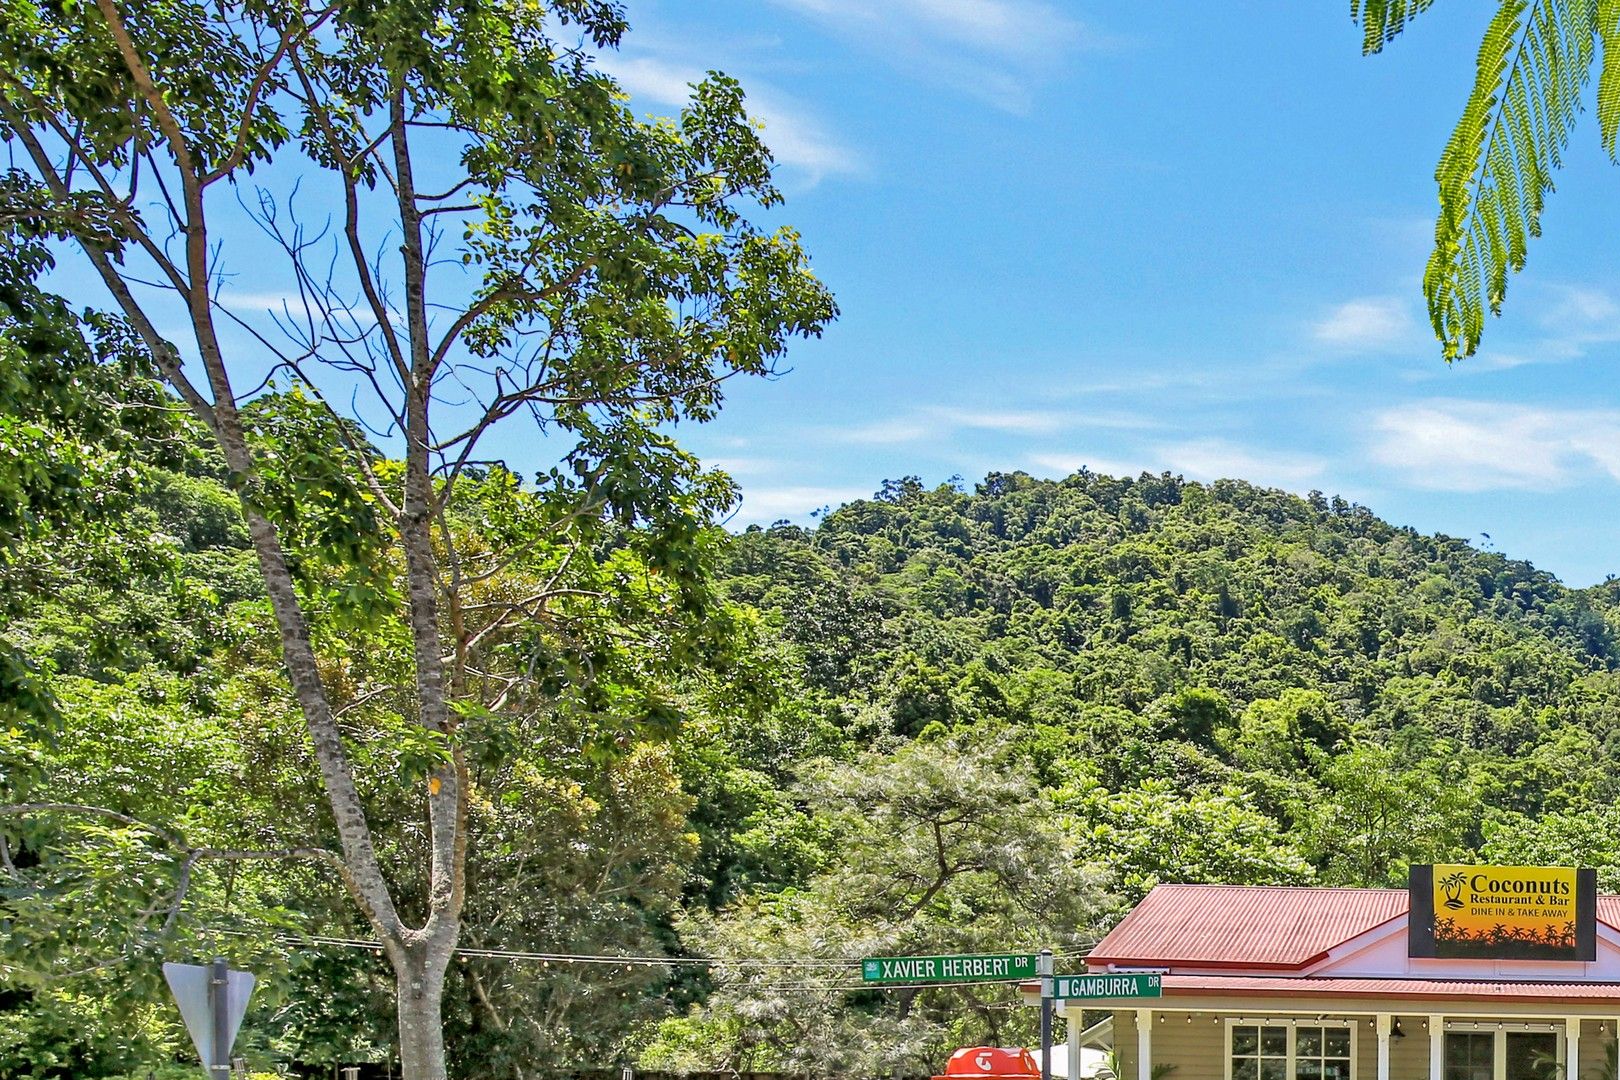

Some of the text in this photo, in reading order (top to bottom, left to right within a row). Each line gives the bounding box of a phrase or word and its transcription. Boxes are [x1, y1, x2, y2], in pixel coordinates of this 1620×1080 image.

[1470, 874, 1570, 895] Coconuts
[1470, 894, 1570, 906] Restaurant & Bar
[1471, 908, 1493, 916] DINE
[1495, 908, 1505, 916] IN
[1517, 909, 1539, 917] TAKE
[1541, 909, 1568, 918] AWAY
[882, 957, 1028, 979] XAVIER HERBERT DR
[1071, 976, 1160, 997] GAMBURRA DR
